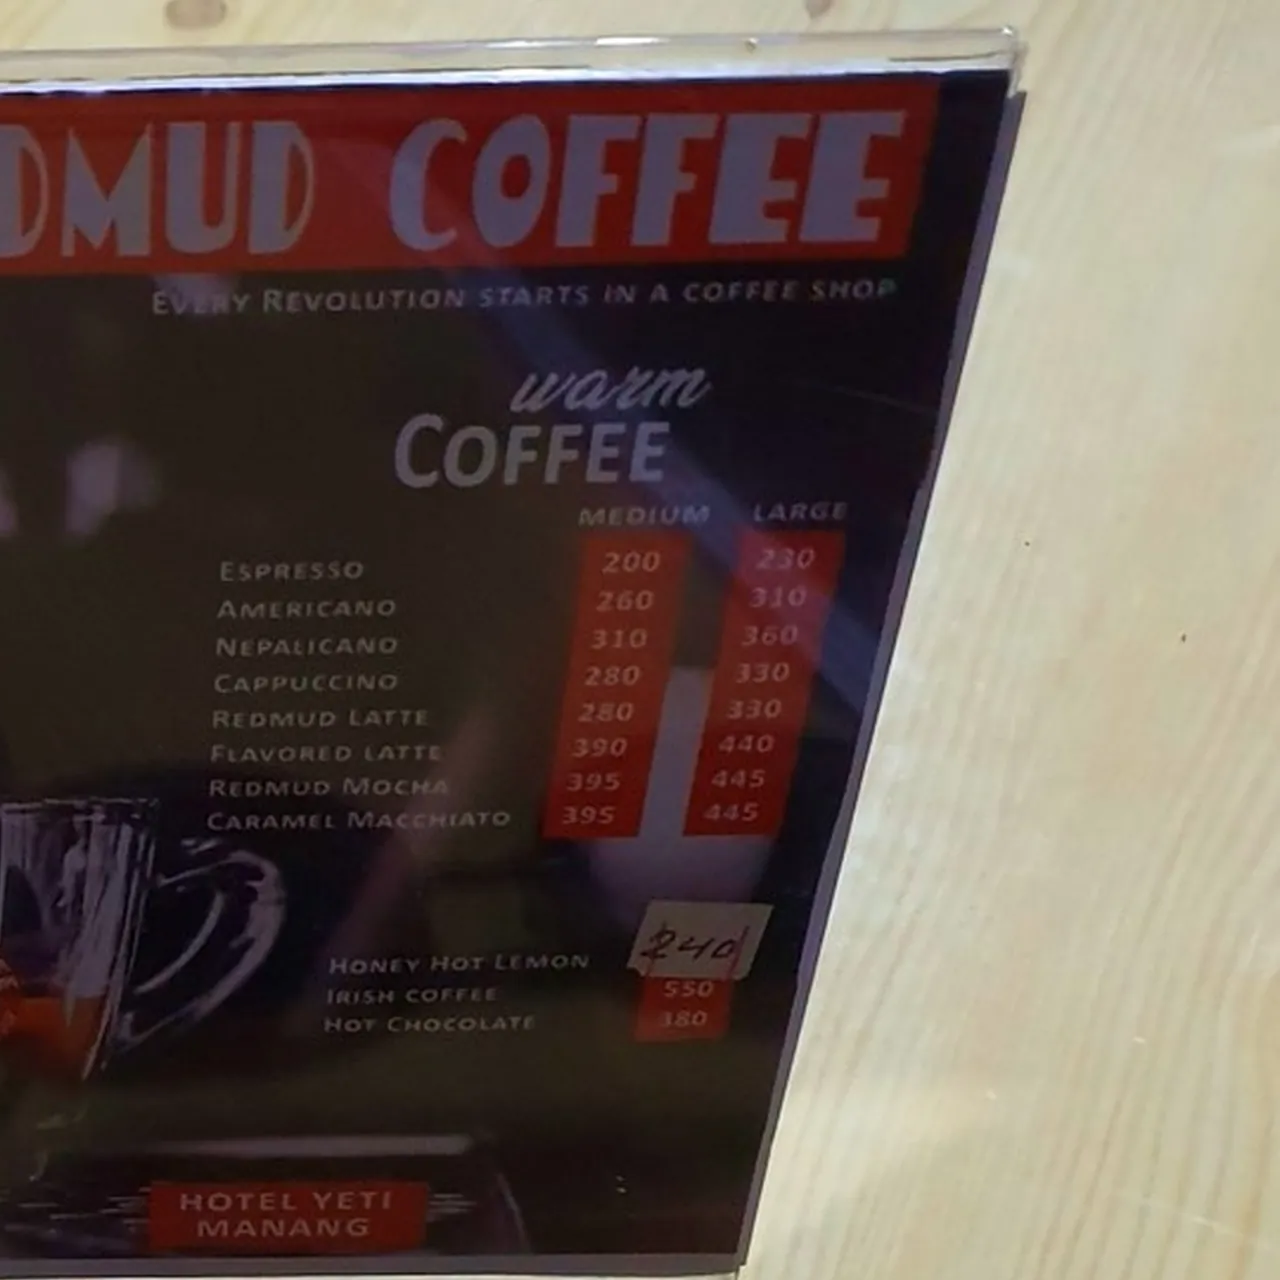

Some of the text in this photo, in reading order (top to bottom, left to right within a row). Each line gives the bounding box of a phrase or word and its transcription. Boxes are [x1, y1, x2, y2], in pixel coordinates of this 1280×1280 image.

[389, 110, 907, 250] COFFEE
[262, 288, 465, 313] REVOLUTION
[479, 285, 589, 307] STARTS
[604, 283, 635, 304] IN
[649, 284, 671, 304] A
[682, 280, 801, 303] COFFEE
[809, 278, 898, 301] SHOP
[509, 365, 713, 413] warm
[394, 413, 670, 488] COFFEE
[578, 501, 848, 526] MEDIUM LARGE
[220, 548, 815, 583] ESPRESSO 200 230
[217, 586, 806, 620] AMERICANO 260 310
[216, 625, 799, 657] NEPALICANO 310 360
[214, 662, 790, 694] CAPPUCCINO 280 330
[212, 699, 782, 730] REDMUD LATTE 280 330
[211, 734, 774, 764] FLAVORED LATTE 390 440
[209, 769, 766, 798] REDMUD MOCHA 395 445
[207, 803, 760, 832] CARAMEL MACCHIATO 395 445
[329, 953, 590, 975] HONEY HOT LEMON
[327, 979, 715, 1005] IRISH COFFEE 550
[324, 1017, 375, 1033] HOT
[387, 1016, 536, 1032] CHOCOLATE
[180, 1190, 392, 1213] HOTEL YETI
[196, 1217, 371, 1238] MANANG
